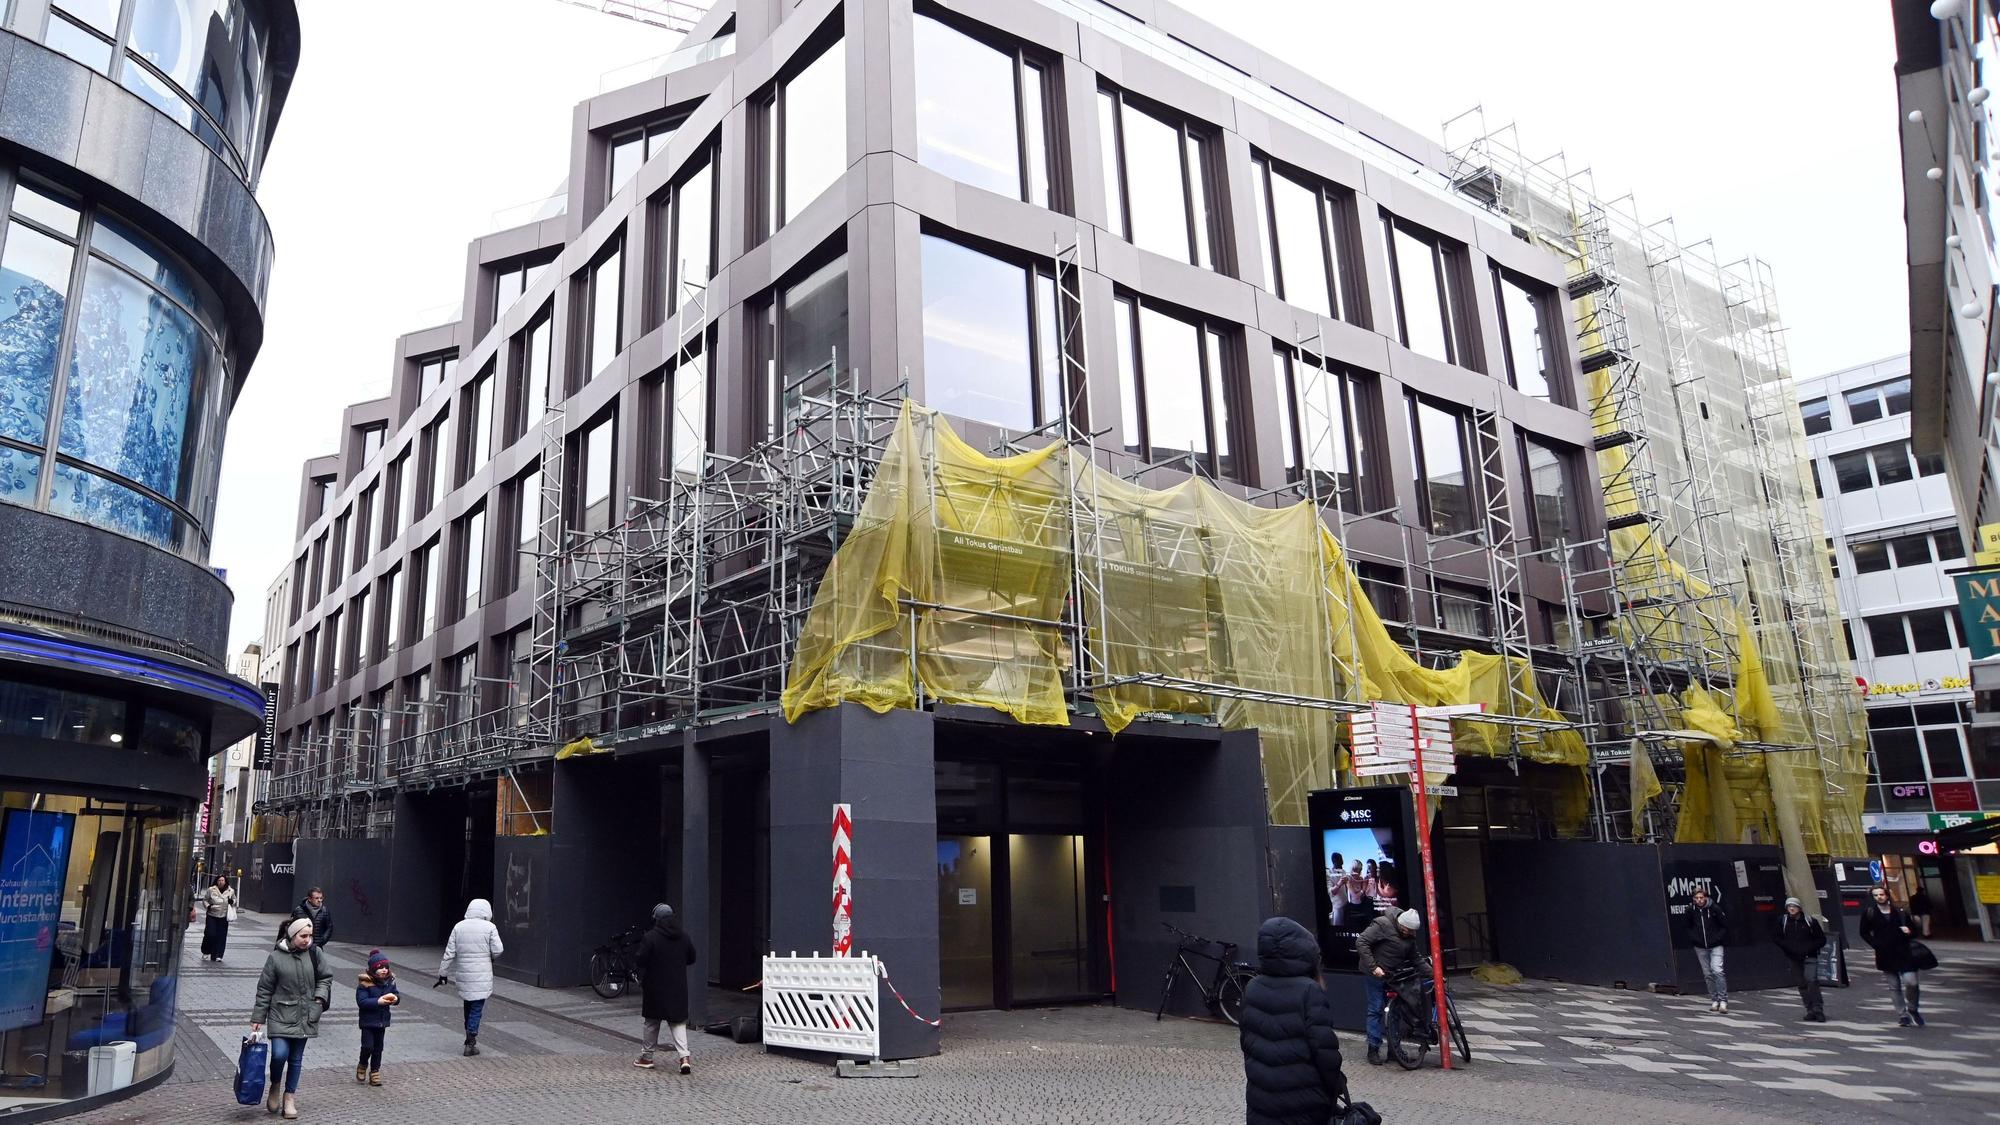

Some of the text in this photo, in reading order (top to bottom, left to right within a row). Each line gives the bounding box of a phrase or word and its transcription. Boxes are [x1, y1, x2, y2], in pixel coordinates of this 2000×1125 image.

[965, 538, 987, 548] Tokus
[1109, 563, 1135, 574] TOKUS
[258, 689, 276, 764] hunkemöller
[1350, 809, 1372, 819] MSC
